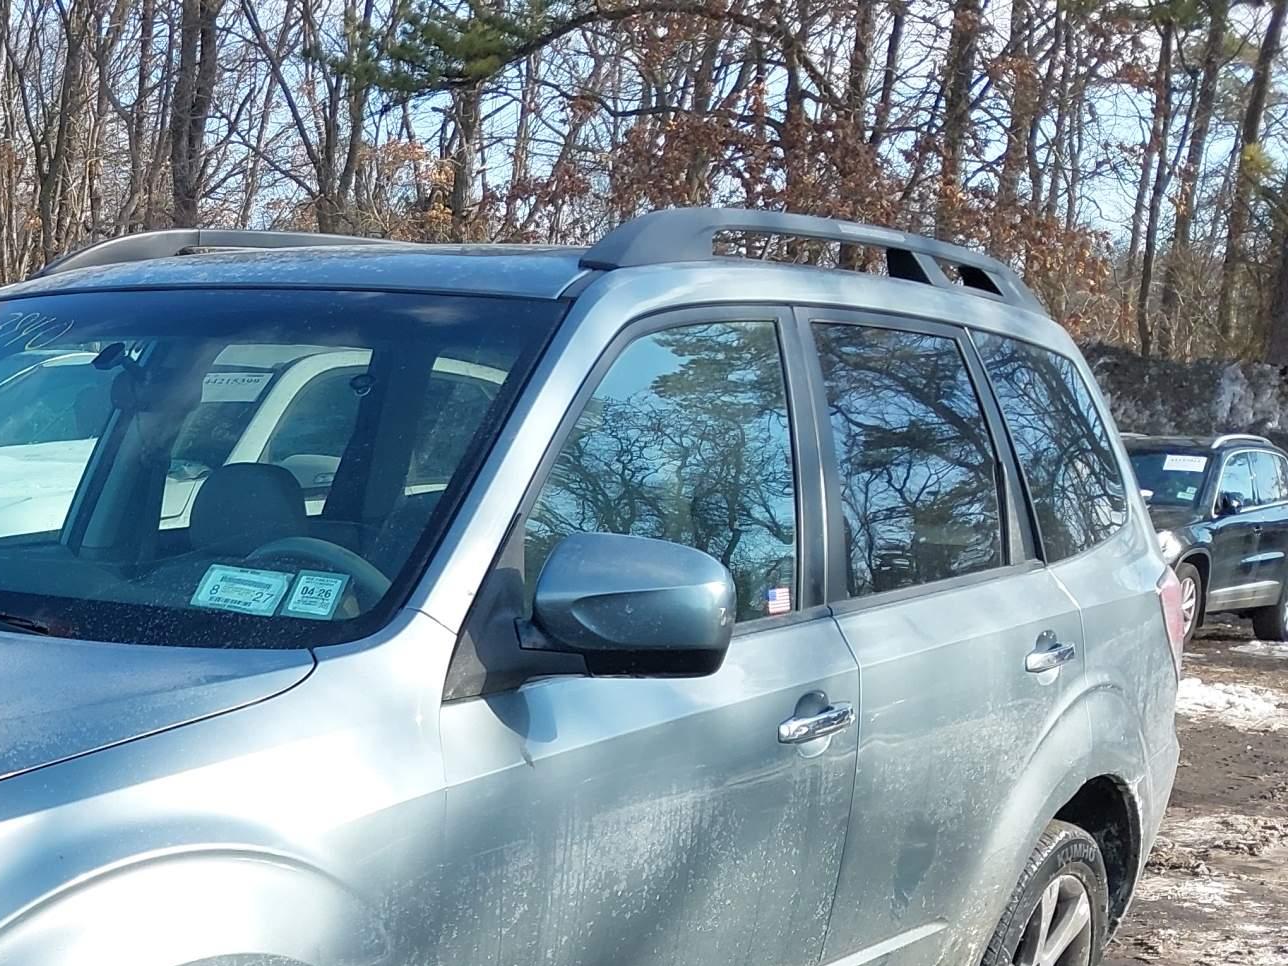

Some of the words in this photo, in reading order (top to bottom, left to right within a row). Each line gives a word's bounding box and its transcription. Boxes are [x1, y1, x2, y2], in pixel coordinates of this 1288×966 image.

[209, 584, 220, 595] 8
[252, 592, 275, 604] 27
[300, 586, 315, 596] 04
[317, 588, 333, 599] 26
[1056, 843, 1097, 868] KUMHO
